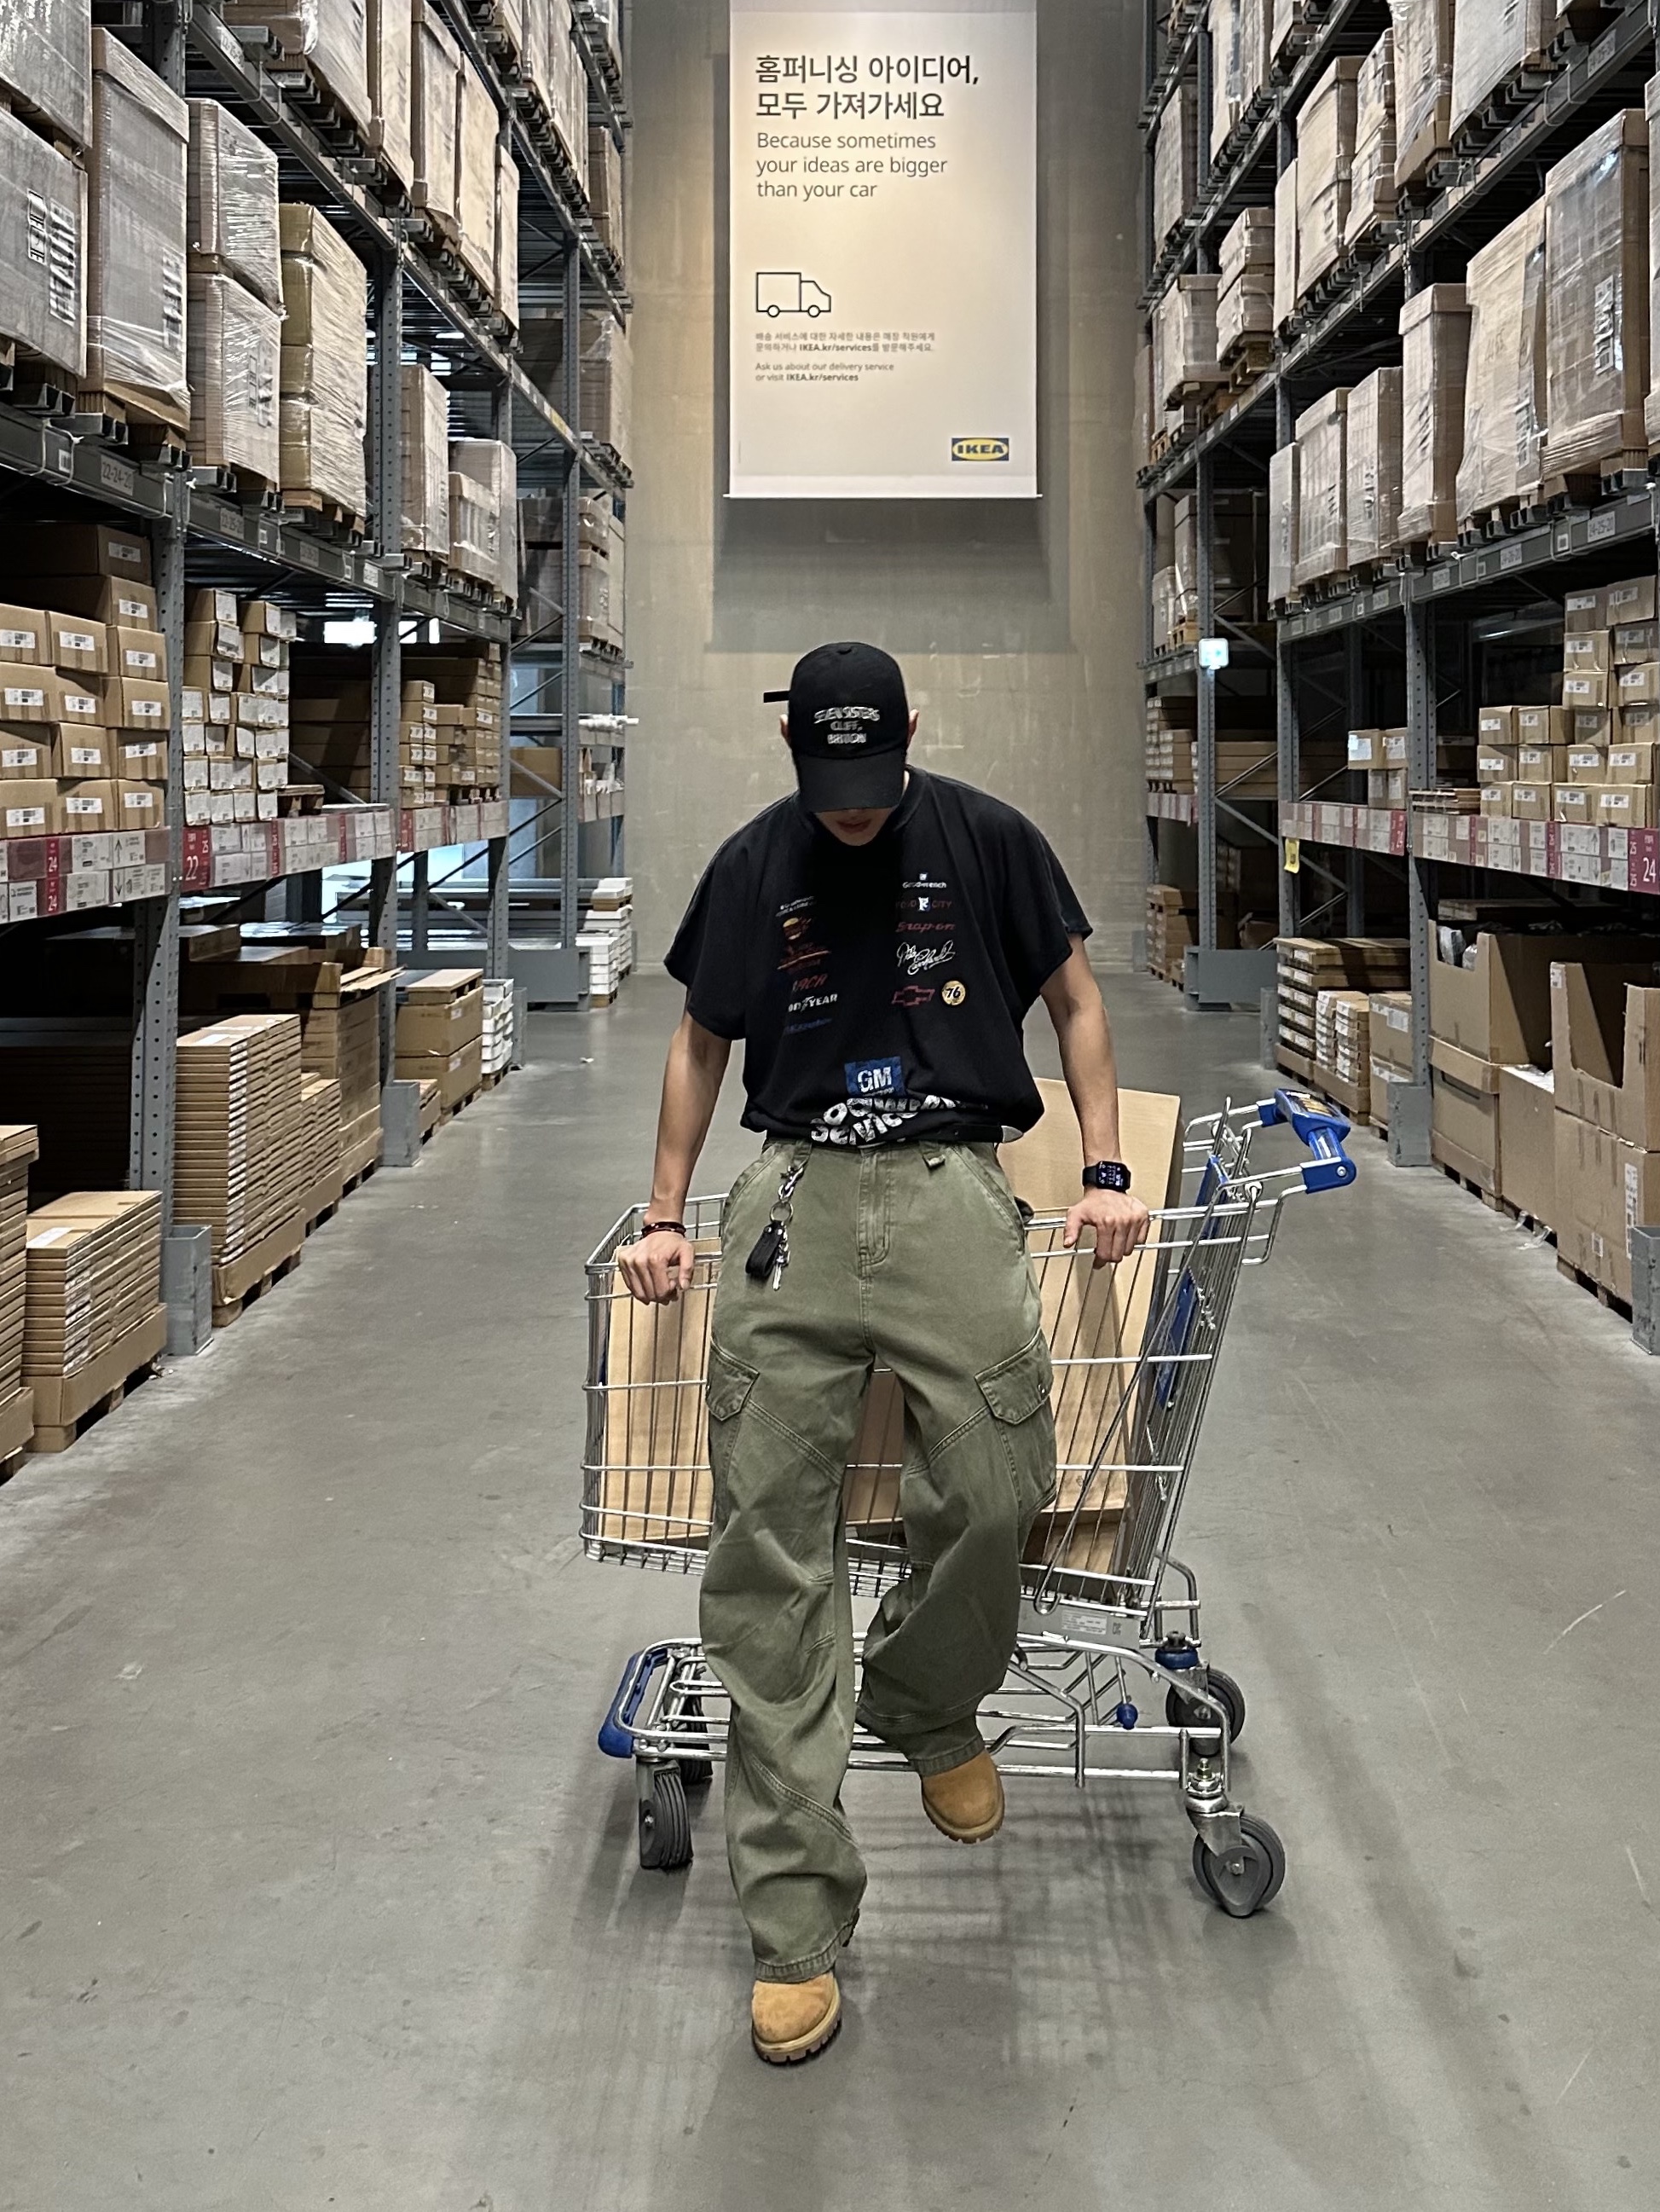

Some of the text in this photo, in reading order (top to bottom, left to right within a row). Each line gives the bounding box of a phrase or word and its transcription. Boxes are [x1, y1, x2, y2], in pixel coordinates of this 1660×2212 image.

[755, 55, 980, 84] 홈퍼니싱 아이디어,
[755, 91, 945, 119] 모두 가져가세요
[756, 132, 936, 148] Because sometimes
[756, 157, 948, 177] your ideas are bigger
[756, 181, 877, 201] than your car
[775, 333, 807, 341] 서비스에
[810, 333, 827, 341] 대한
[829, 333, 853, 341] 자세한
[829, 362, 863, 372] delivery
[957, 444, 1004, 454] IKEA
[48, 856, 58, 872] 24
[185, 855, 199, 881] 22
[1643, 857, 1656, 883] 24
[48, 895, 58, 912] 24
[946, 986, 961, 999] 76
[858, 1066, 893, 1093] GM
